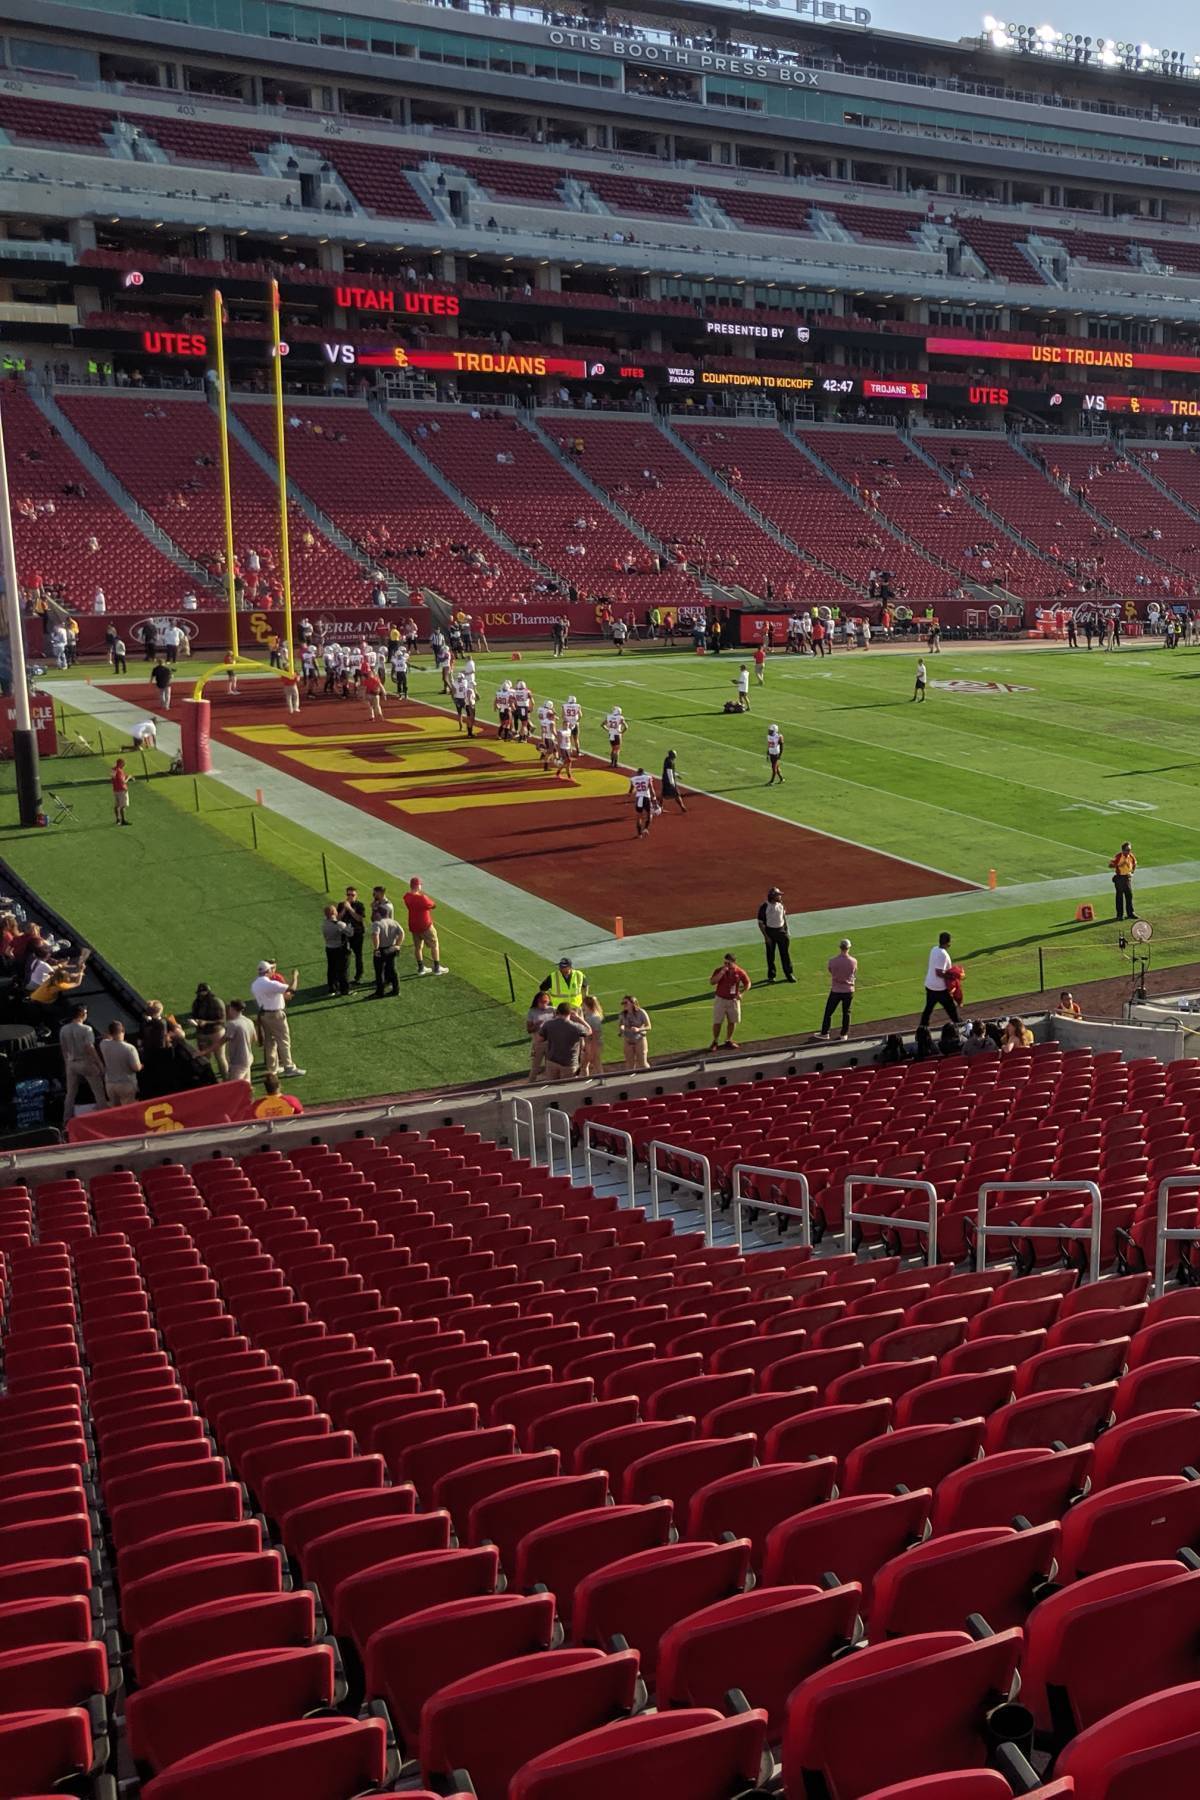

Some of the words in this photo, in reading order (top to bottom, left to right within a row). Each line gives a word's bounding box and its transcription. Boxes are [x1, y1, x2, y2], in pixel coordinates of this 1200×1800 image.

[796, 0, 872, 25] FIELD
[549, 31, 601, 51] OTIS
[613, 41, 688, 64] BOOTH
[701, 55, 767, 77] PRESS
[780, 69, 820, 86] BOX
[3, 80, 23, 92] 402
[176, 104, 196, 117] 403
[335, 287, 394, 312] UTAH
[404, 292, 460, 316] UTES
[707, 322, 769, 337] PRESENTED
[772, 327, 785, 339] BY
[144, 331, 207, 355] UTES
[324, 343, 355, 364] VS
[1032, 346, 1061, 363] USC
[1066, 348, 1133, 368] TROJANS
[453, 352, 546, 376] TROJANS
[620, 367, 644, 378] UTES
[668, 367, 694, 376] WELLS
[669, 376, 694, 384] FARGO
[702, 372, 761, 388] COUNTDOWN
[763, 376, 775, 388] TO
[776, 377, 815, 389] KICKOFF
[823, 379, 854, 392] 42:47
[871, 384, 906, 394] TROJANS
[969, 386, 1009, 405] UTES
[1085, 394, 1105, 410] VS
[678, 606, 705, 615] CREDI
[486, 612, 561, 626] USCPharmac
[8, 706, 53, 721] MCLE
[566, 708, 576, 717] 93
[635, 781, 647, 792] 26
[1081, 906, 1093, 920] G
